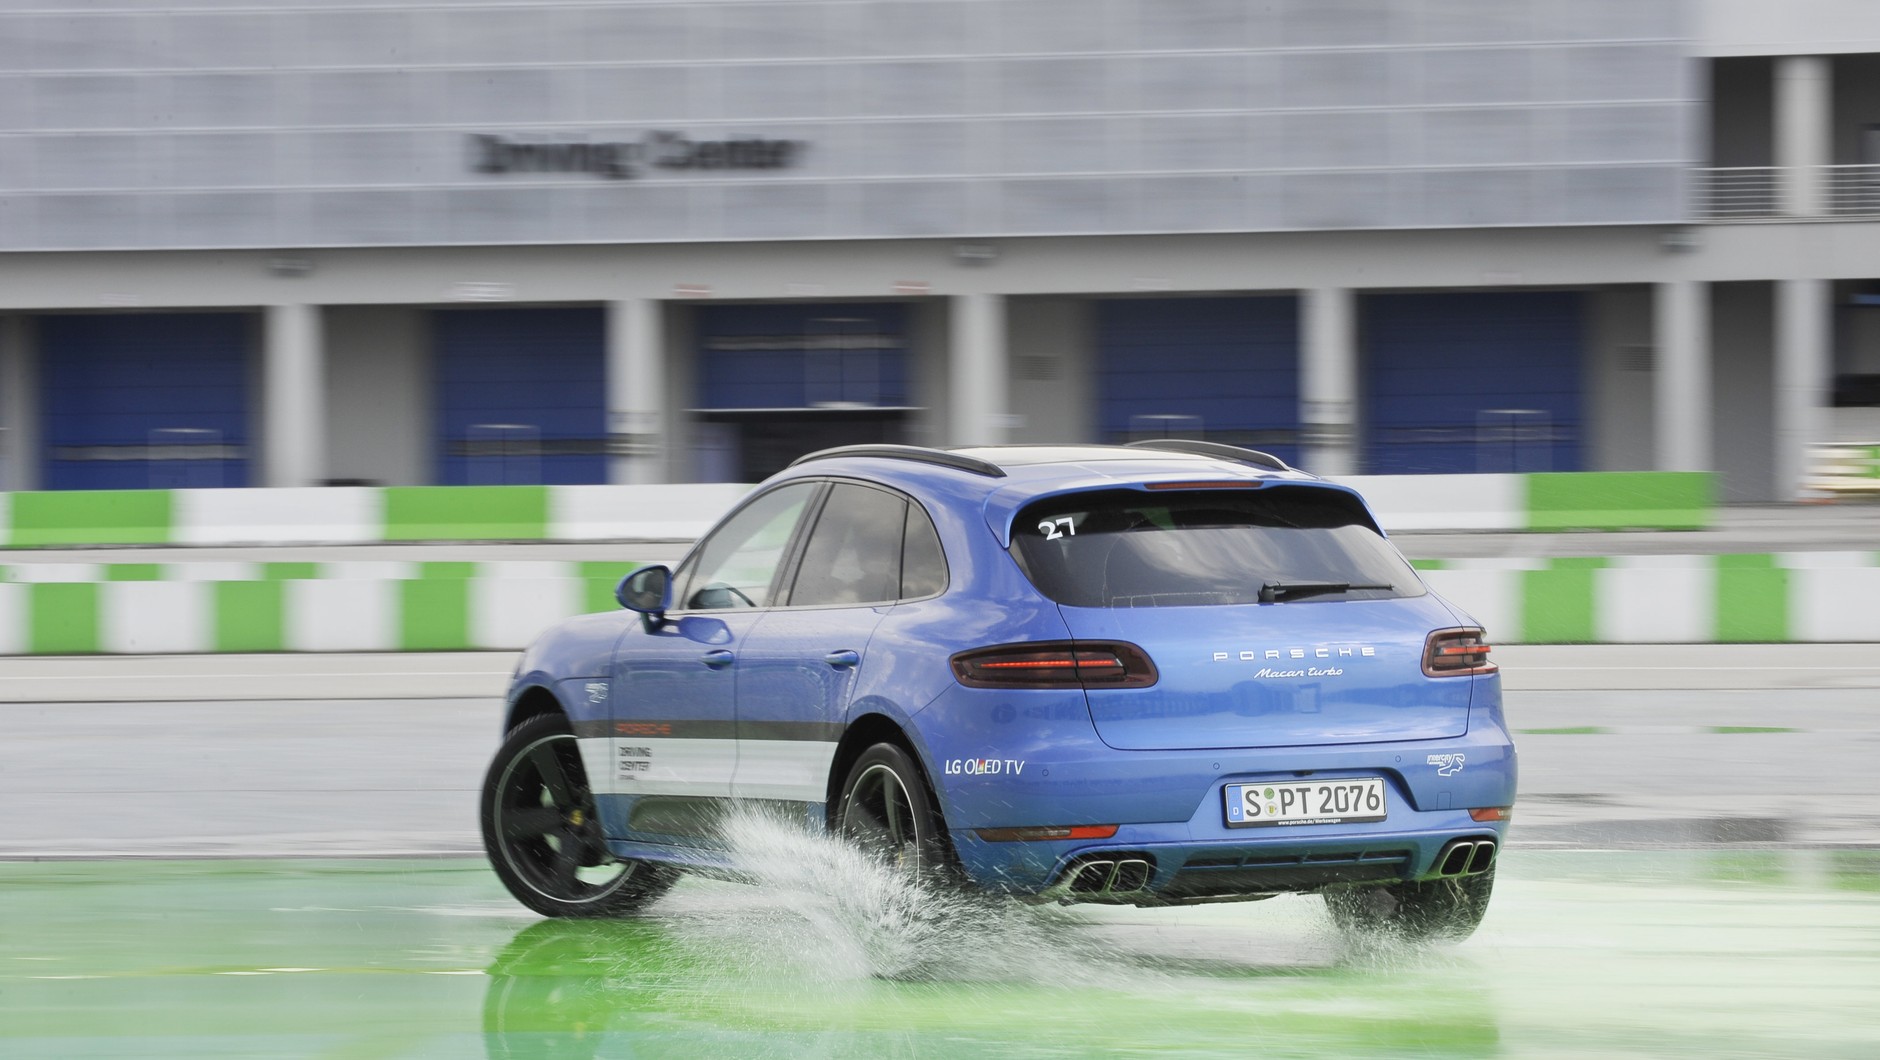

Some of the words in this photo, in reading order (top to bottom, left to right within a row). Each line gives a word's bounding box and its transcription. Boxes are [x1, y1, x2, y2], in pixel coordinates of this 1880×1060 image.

[1038, 516, 1075, 540] 27
[1213, 647, 1376, 662] PORSCHE
[1253, 667, 1304, 679] Macan
[1307, 666, 1343, 678] turbo
[945, 760, 961, 775] LG
[964, 758, 1001, 775] OLED
[1005, 760, 1025, 775] TV
[1245, 790, 1261, 817] S
[1278, 787, 1311, 815] PT
[1318, 785, 1380, 814] 2076
